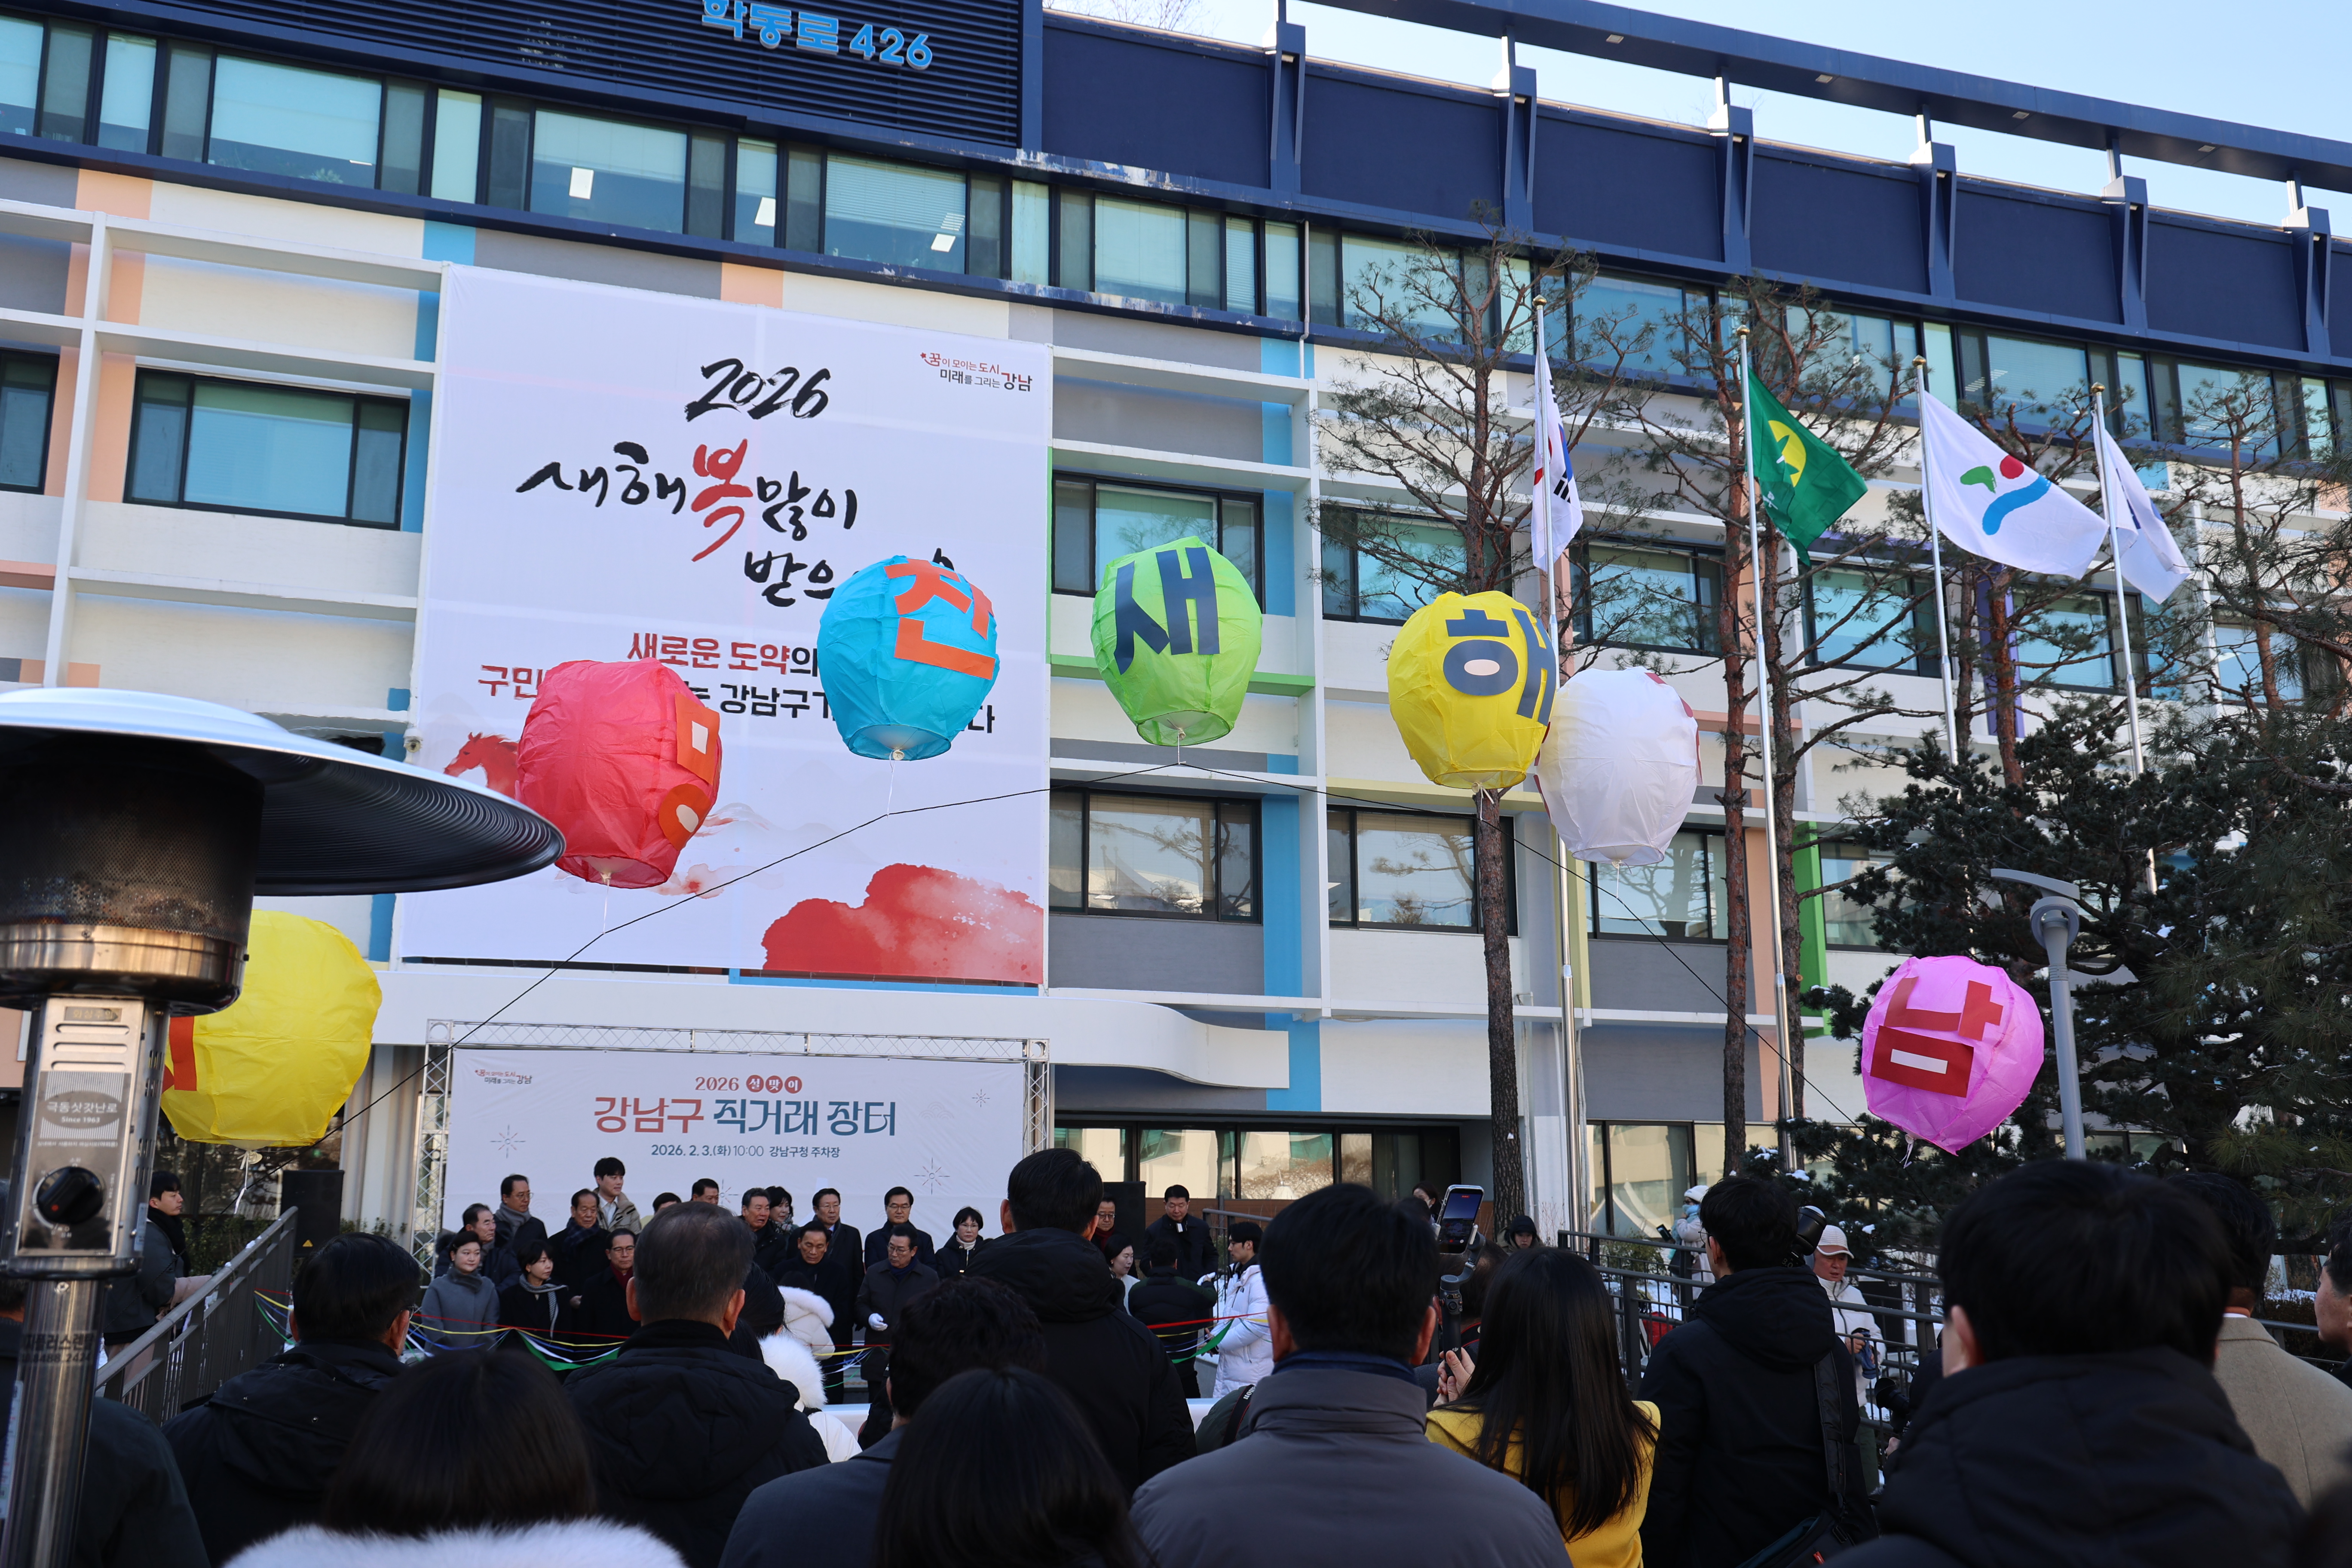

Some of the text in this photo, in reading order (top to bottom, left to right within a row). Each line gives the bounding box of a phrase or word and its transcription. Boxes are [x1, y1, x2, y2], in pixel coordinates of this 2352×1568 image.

[849, 24, 932, 70] 426
[928, 352, 999, 374] 꿈이 모이는 도시
[940, 369, 1032, 392] 미래를 그리는 강남
[685, 358, 831, 422] 2026
[1115, 546, 1220, 674] 새
[627, 632, 818, 677] 새로운 도약의
[1443, 607, 1556, 727] 해
[1870, 976, 2003, 1098] 남
[516, 1075, 533, 1084] 강남
[695, 1076, 801, 1092] 2026 설맞이
[594, 1096, 896, 1136] 강남구 직거래 장터
[769, 1146, 808, 1158] 강남구청
[811, 1146, 840, 1158] 주차장
